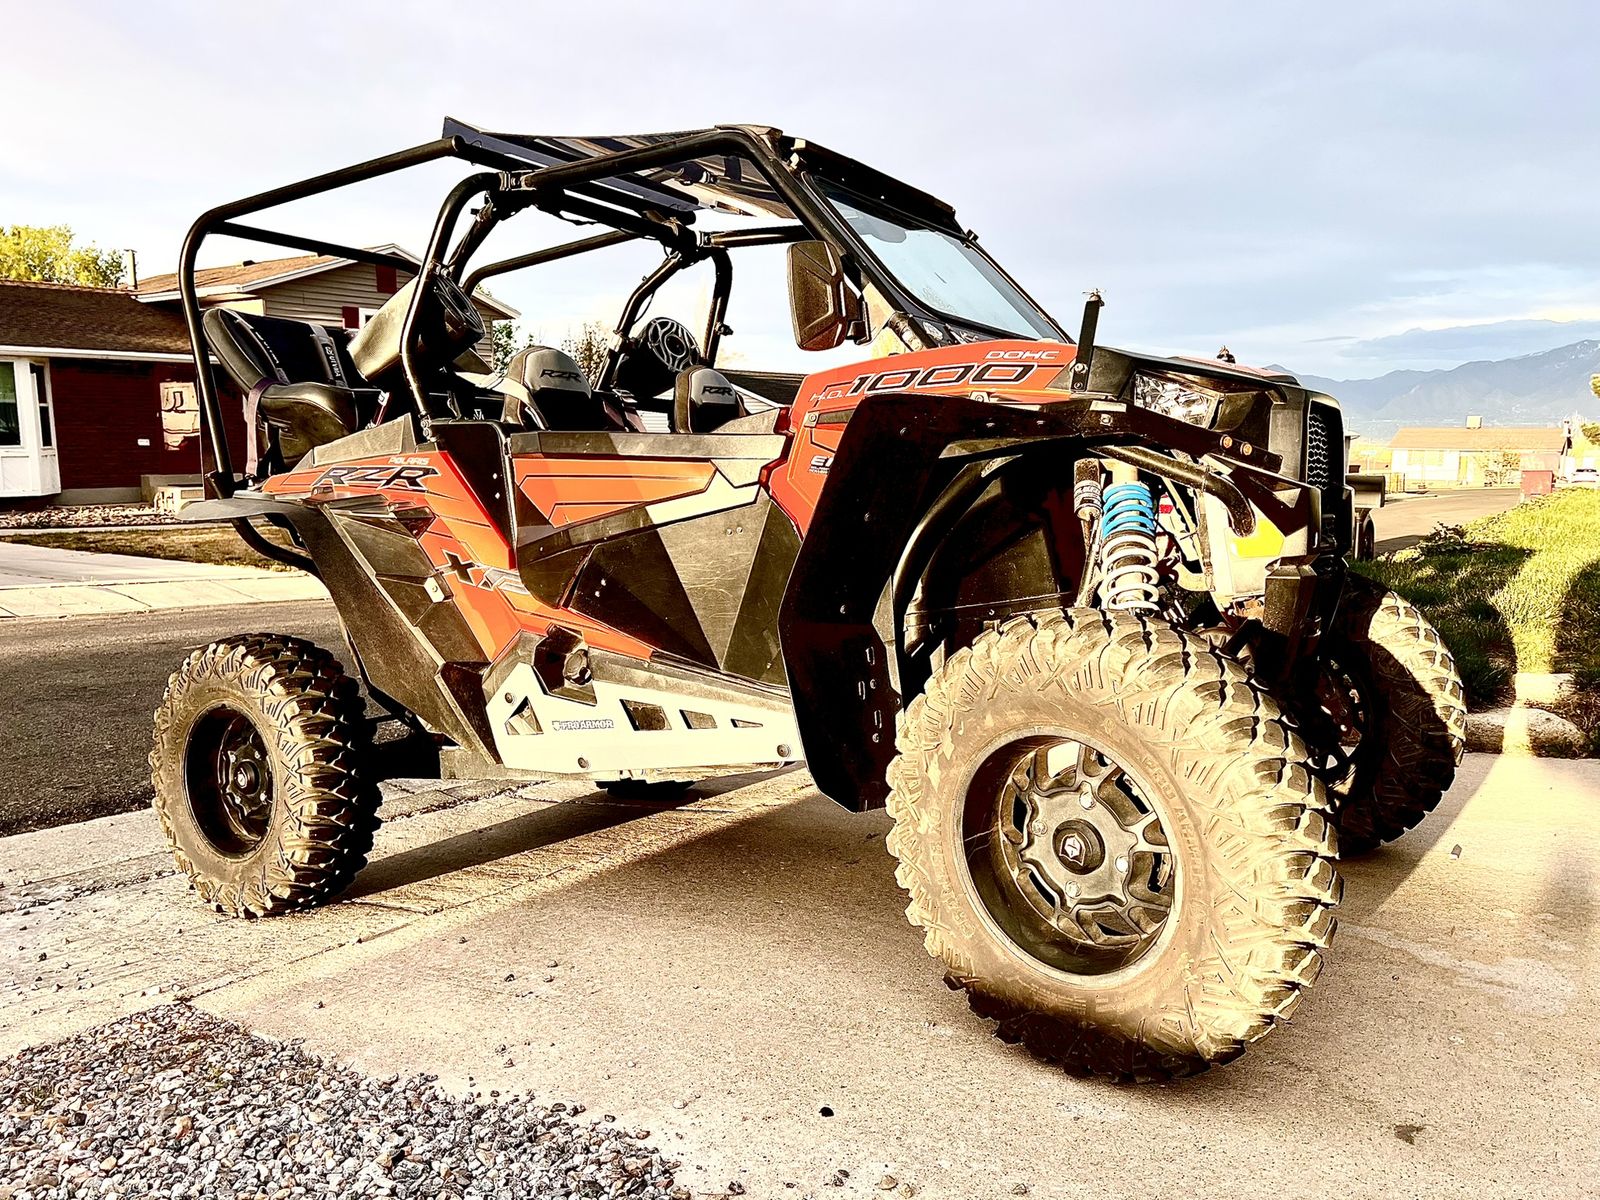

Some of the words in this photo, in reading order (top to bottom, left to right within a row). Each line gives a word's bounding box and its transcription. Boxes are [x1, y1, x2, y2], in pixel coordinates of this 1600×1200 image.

[984, 350, 1060, 361] DOHC
[540, 368, 581, 383] RZR
[847, 362, 1037, 396] 1000
[701, 384, 732, 396] RZR
[387, 456, 430, 466] POLARIS
[311, 464, 442, 490] RZR
[580, 719, 614, 730] ARMOR
